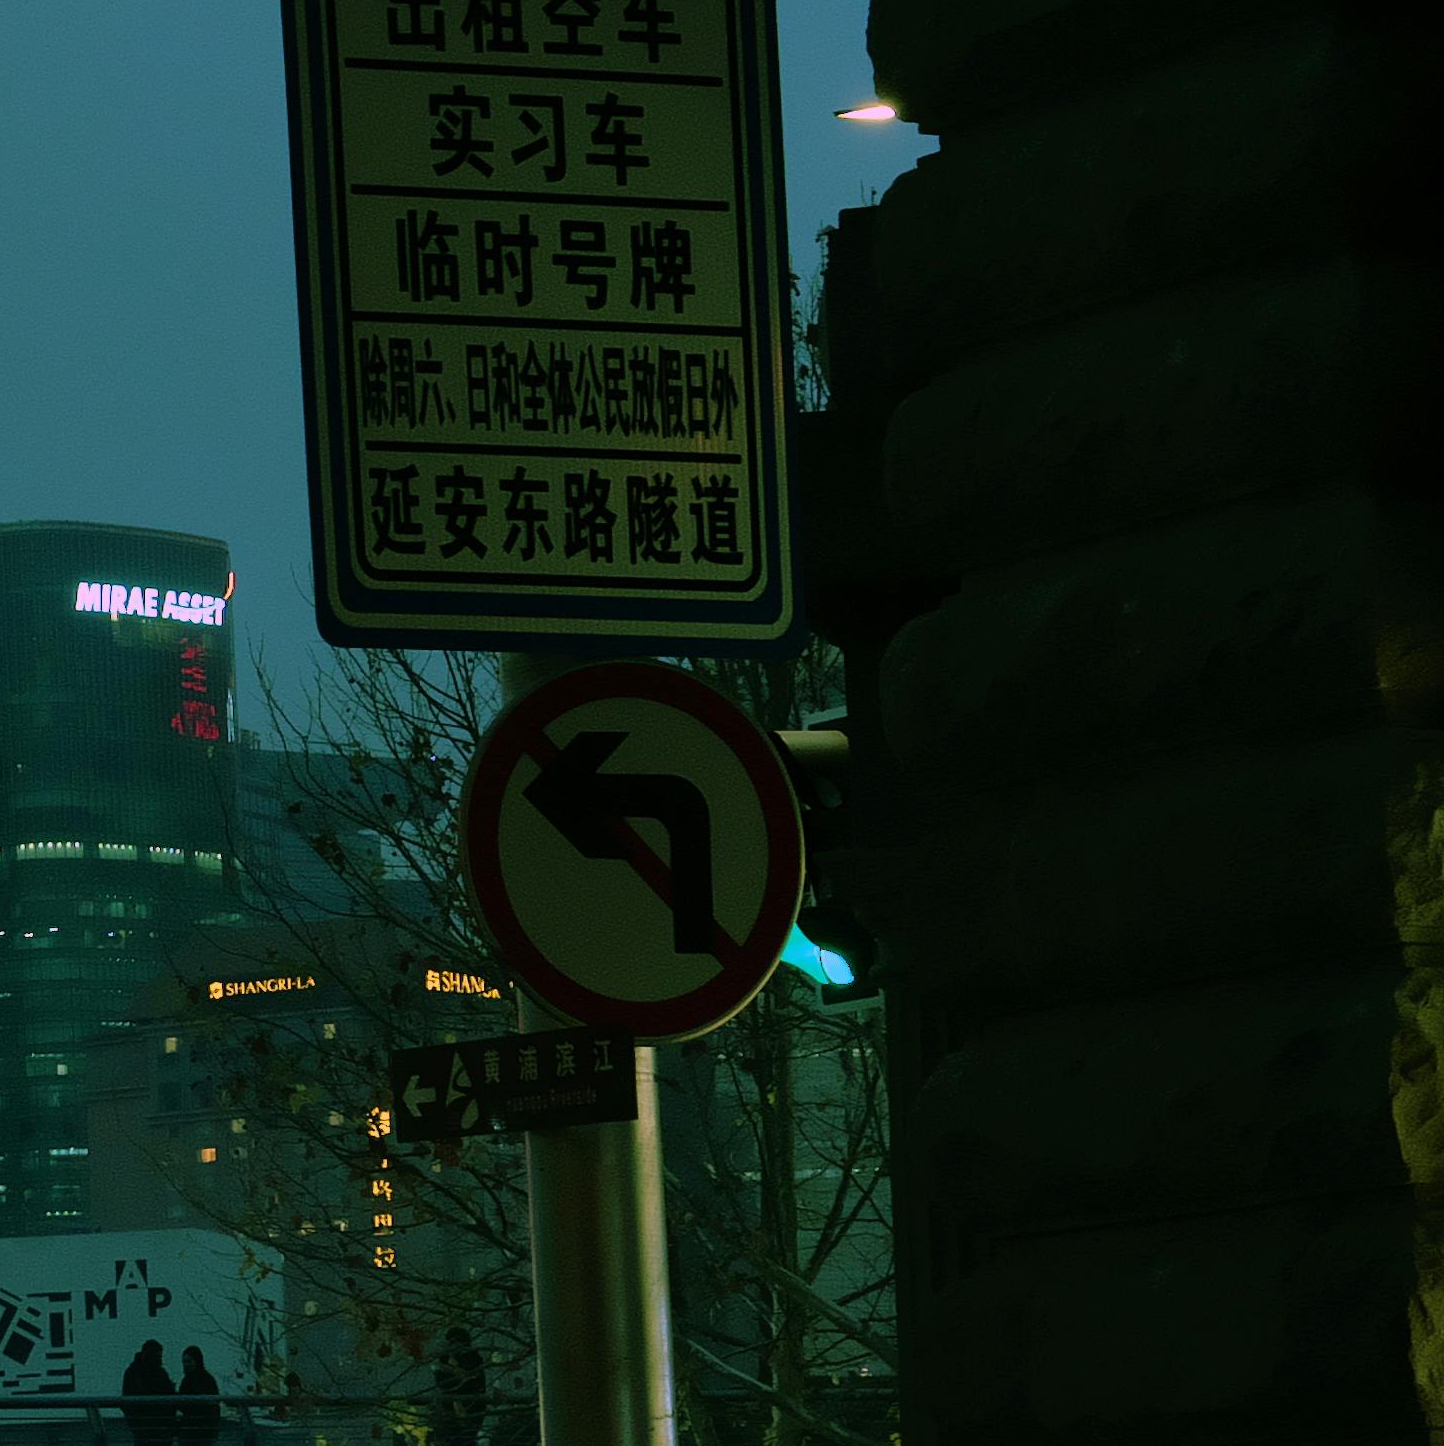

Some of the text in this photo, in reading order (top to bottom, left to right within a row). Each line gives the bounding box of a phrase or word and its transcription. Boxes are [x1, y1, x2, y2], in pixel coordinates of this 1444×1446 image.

[428, 84, 650, 186] 实习车
[395, 208, 696, 316] 临时号牌
[360, 335, 738, 441] 除周六、日和全体公民放假日外
[369, 463, 745, 566] 延安东路隧道
[75, 581, 159, 618] MIRAE
[225, 975, 317, 997] SHANGRI-LA
[482, 1039, 616, 1084] 黄浦滨江
